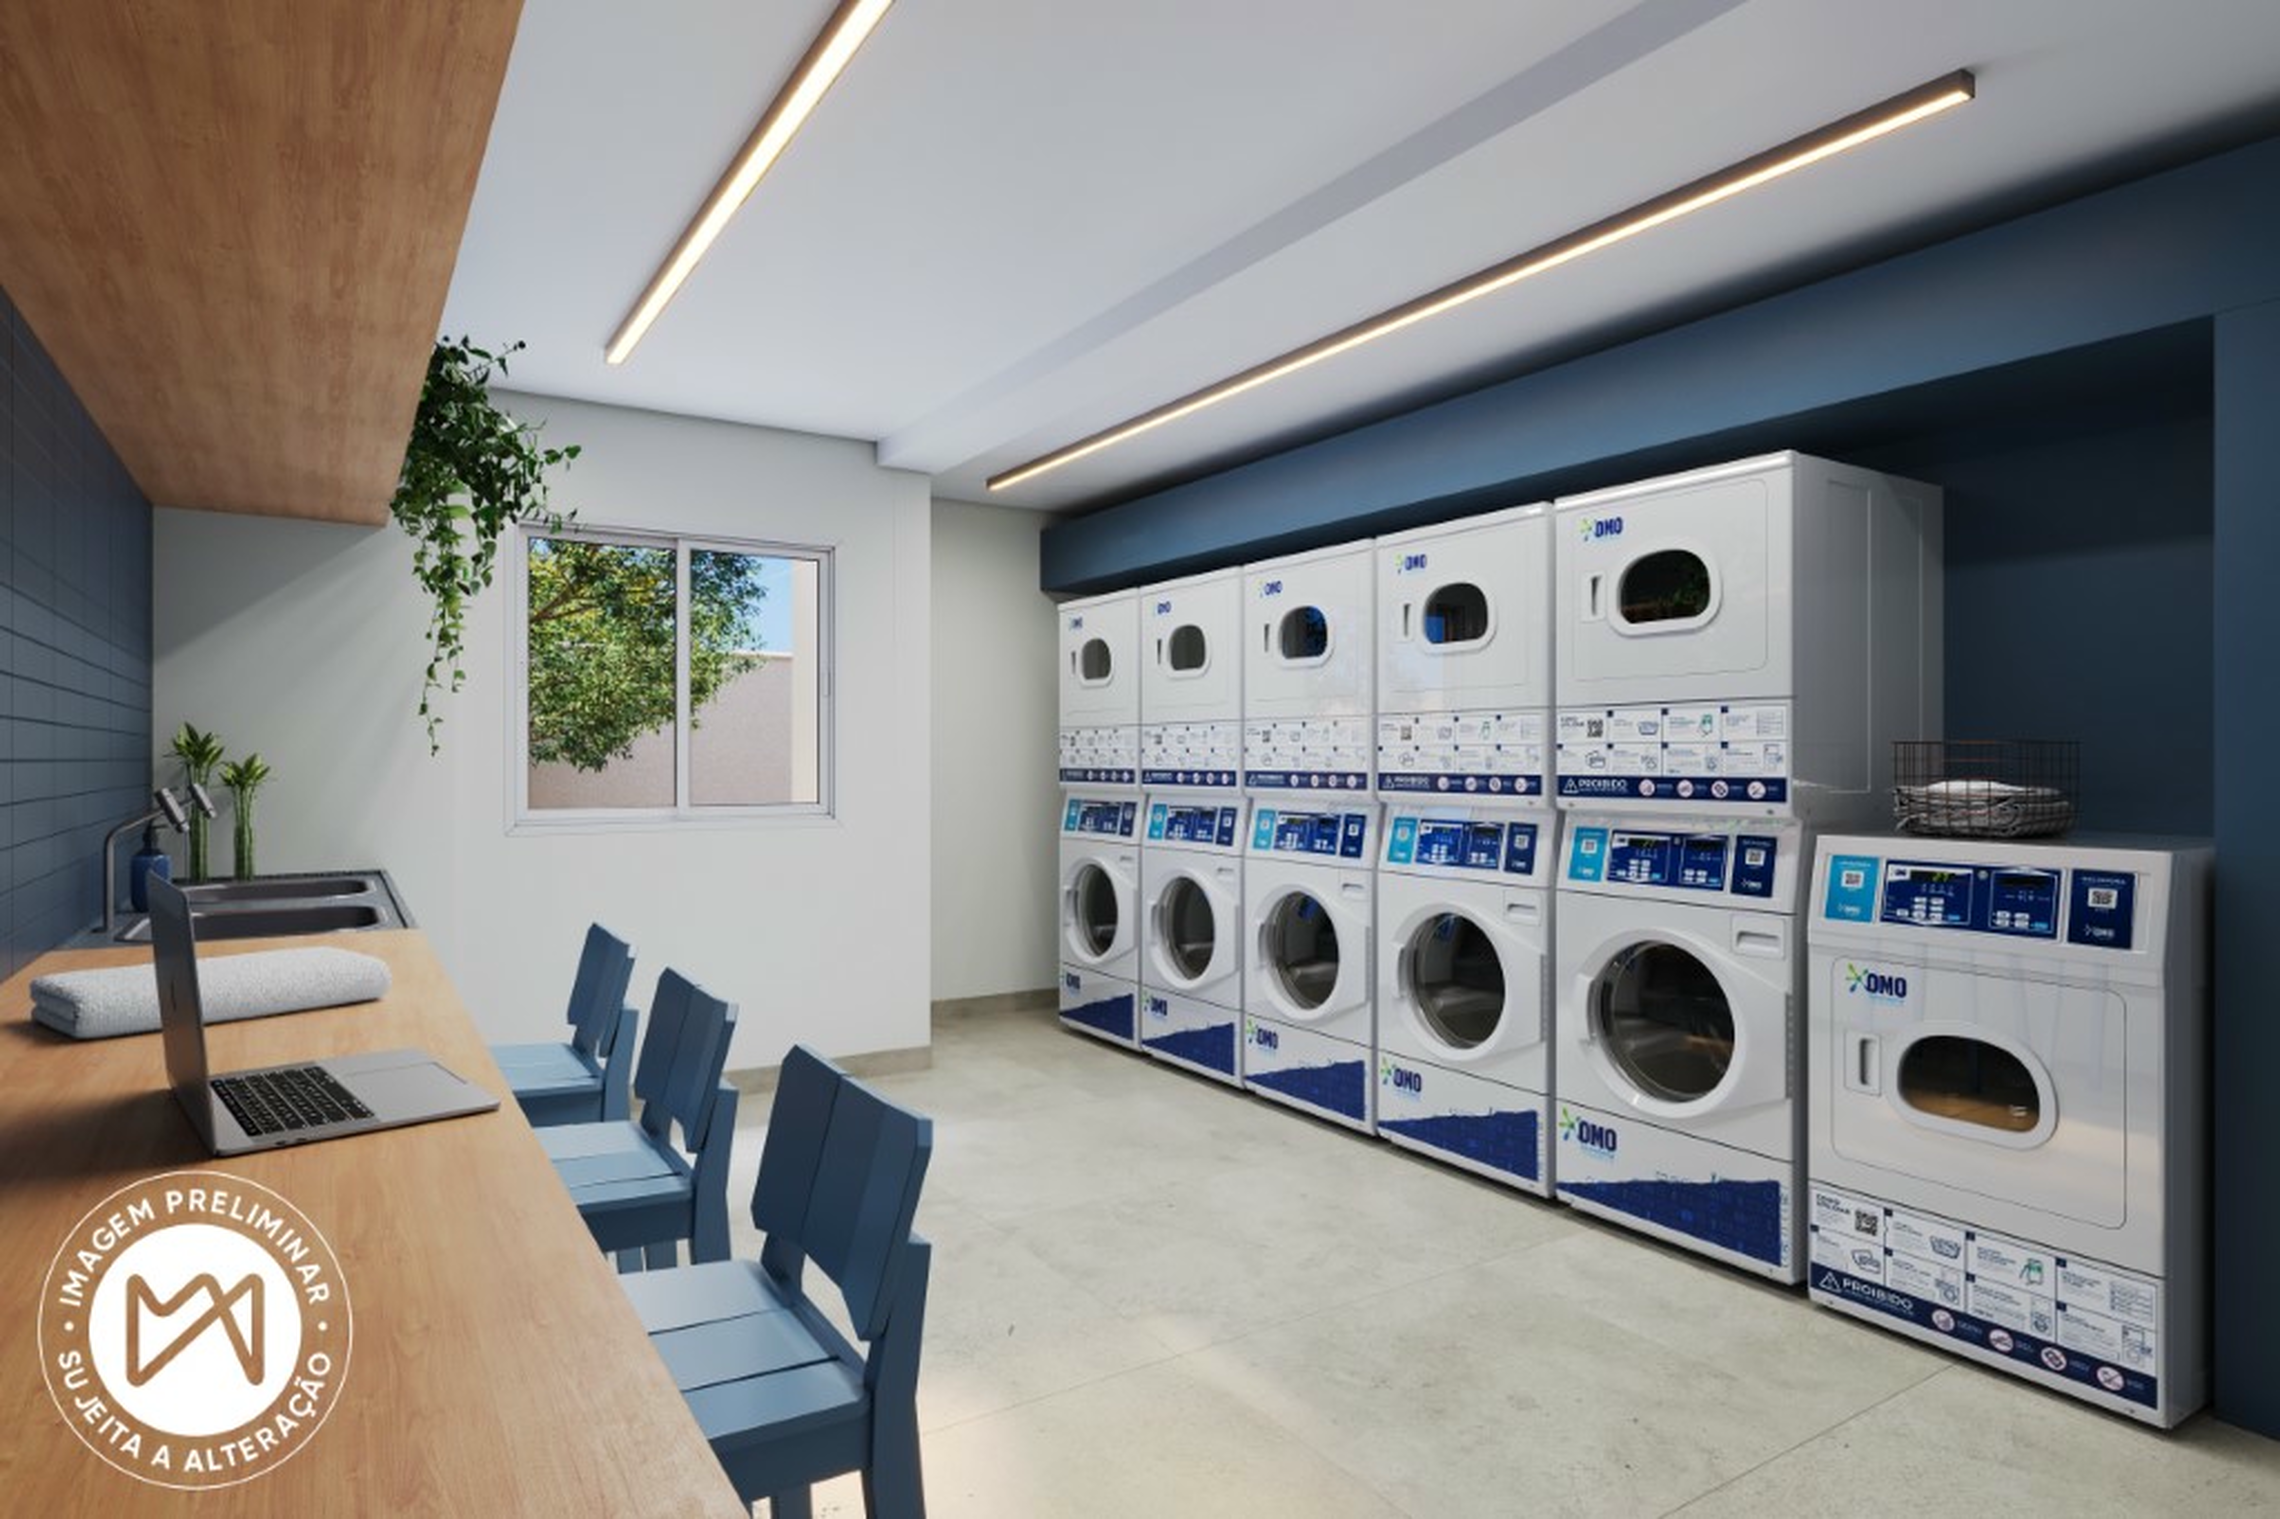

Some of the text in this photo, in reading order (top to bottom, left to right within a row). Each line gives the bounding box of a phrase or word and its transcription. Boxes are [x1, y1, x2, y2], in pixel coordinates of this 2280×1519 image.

[1594, 516, 1623, 538] OMO
[1866, 972, 1907, 998] OMO
[1393, 1067, 1422, 1092] OMO
[1577, 1120, 1617, 1152] OMO
[1842, 1278, 1914, 1310] PROIBIDO
